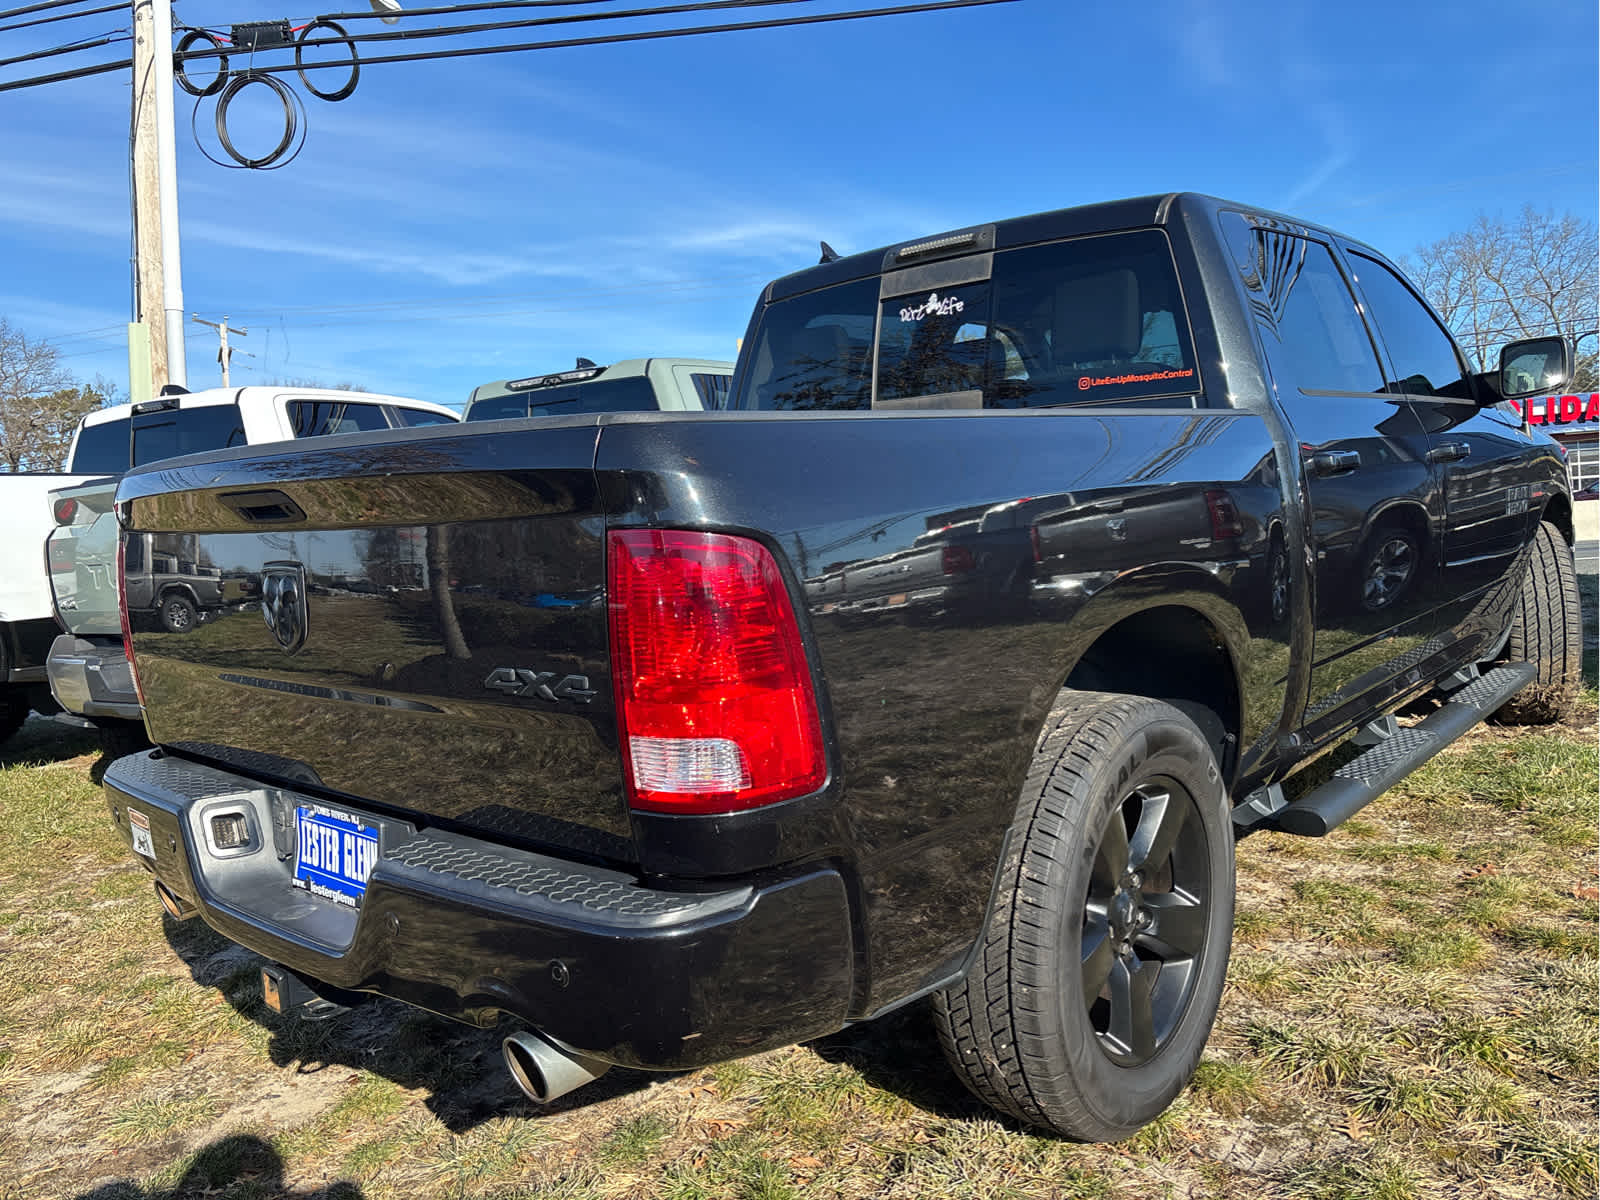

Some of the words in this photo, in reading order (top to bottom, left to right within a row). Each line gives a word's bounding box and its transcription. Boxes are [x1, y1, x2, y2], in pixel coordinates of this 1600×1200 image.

[899, 304, 928, 322] Dirt
[936, 296, 964, 315] Life
[1091, 369, 1193, 386] LiteEmUpMosquitoControl
[1510, 393, 1600, 425] LIDA
[301, 820, 340, 873] LESTER
